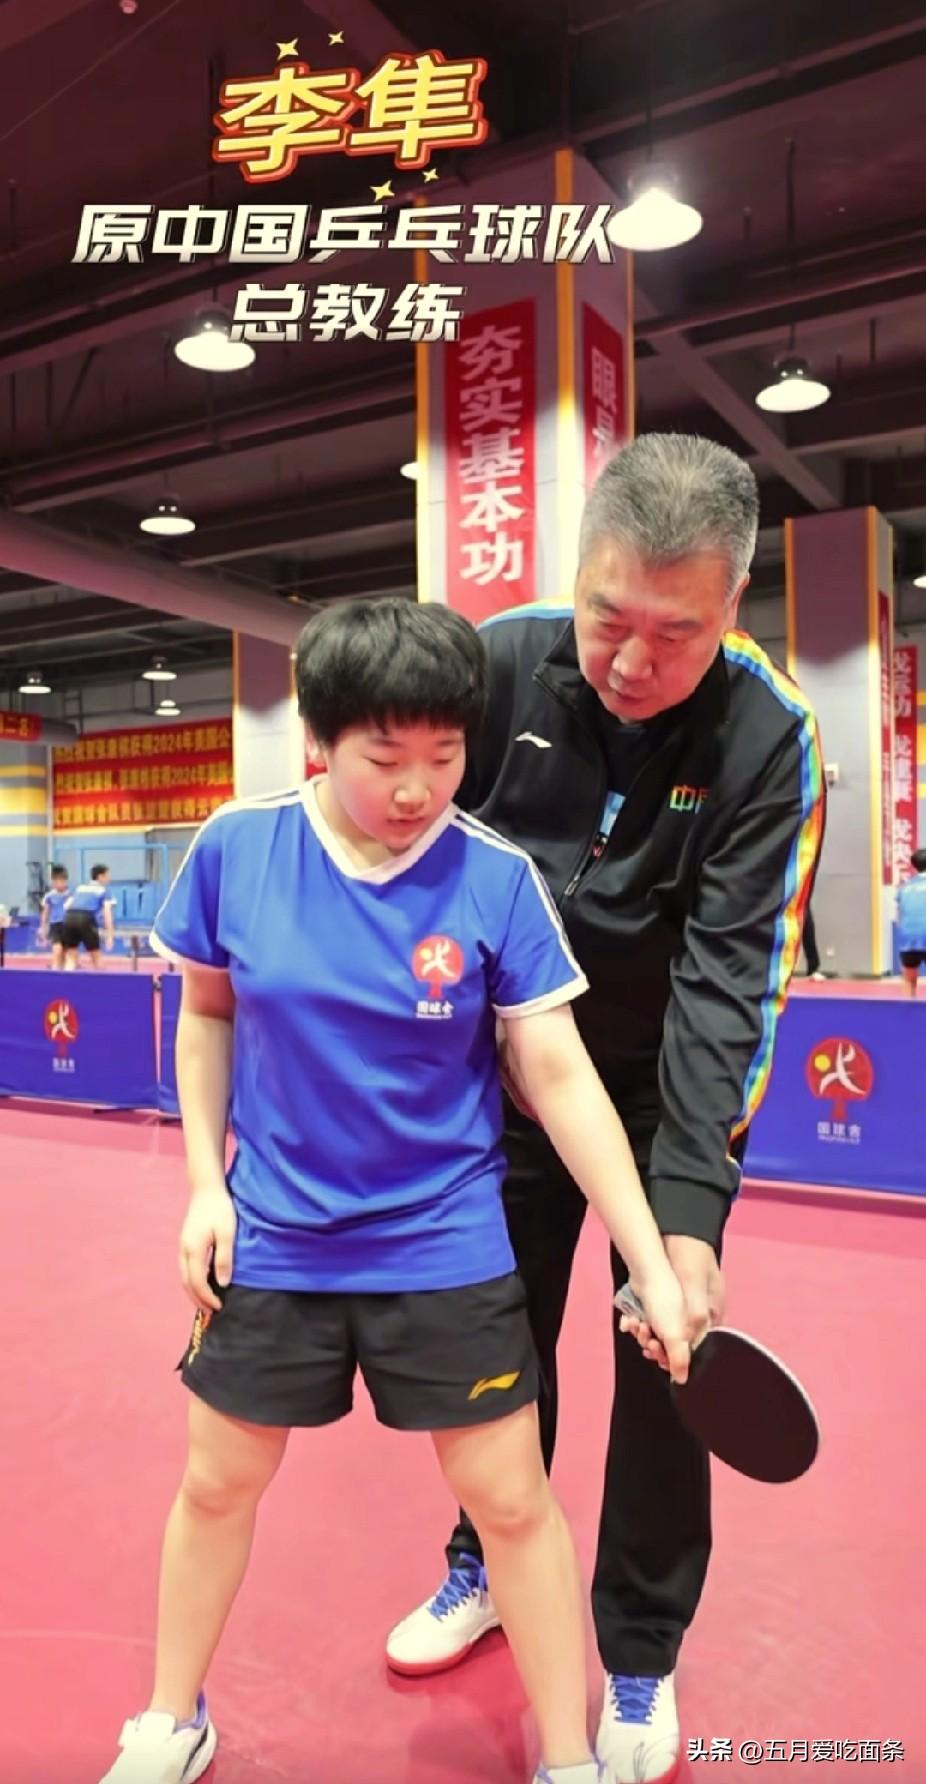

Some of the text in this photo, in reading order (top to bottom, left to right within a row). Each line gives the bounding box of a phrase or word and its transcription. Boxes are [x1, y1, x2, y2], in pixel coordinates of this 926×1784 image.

[458, 324, 525, 587] 夯实基本功
